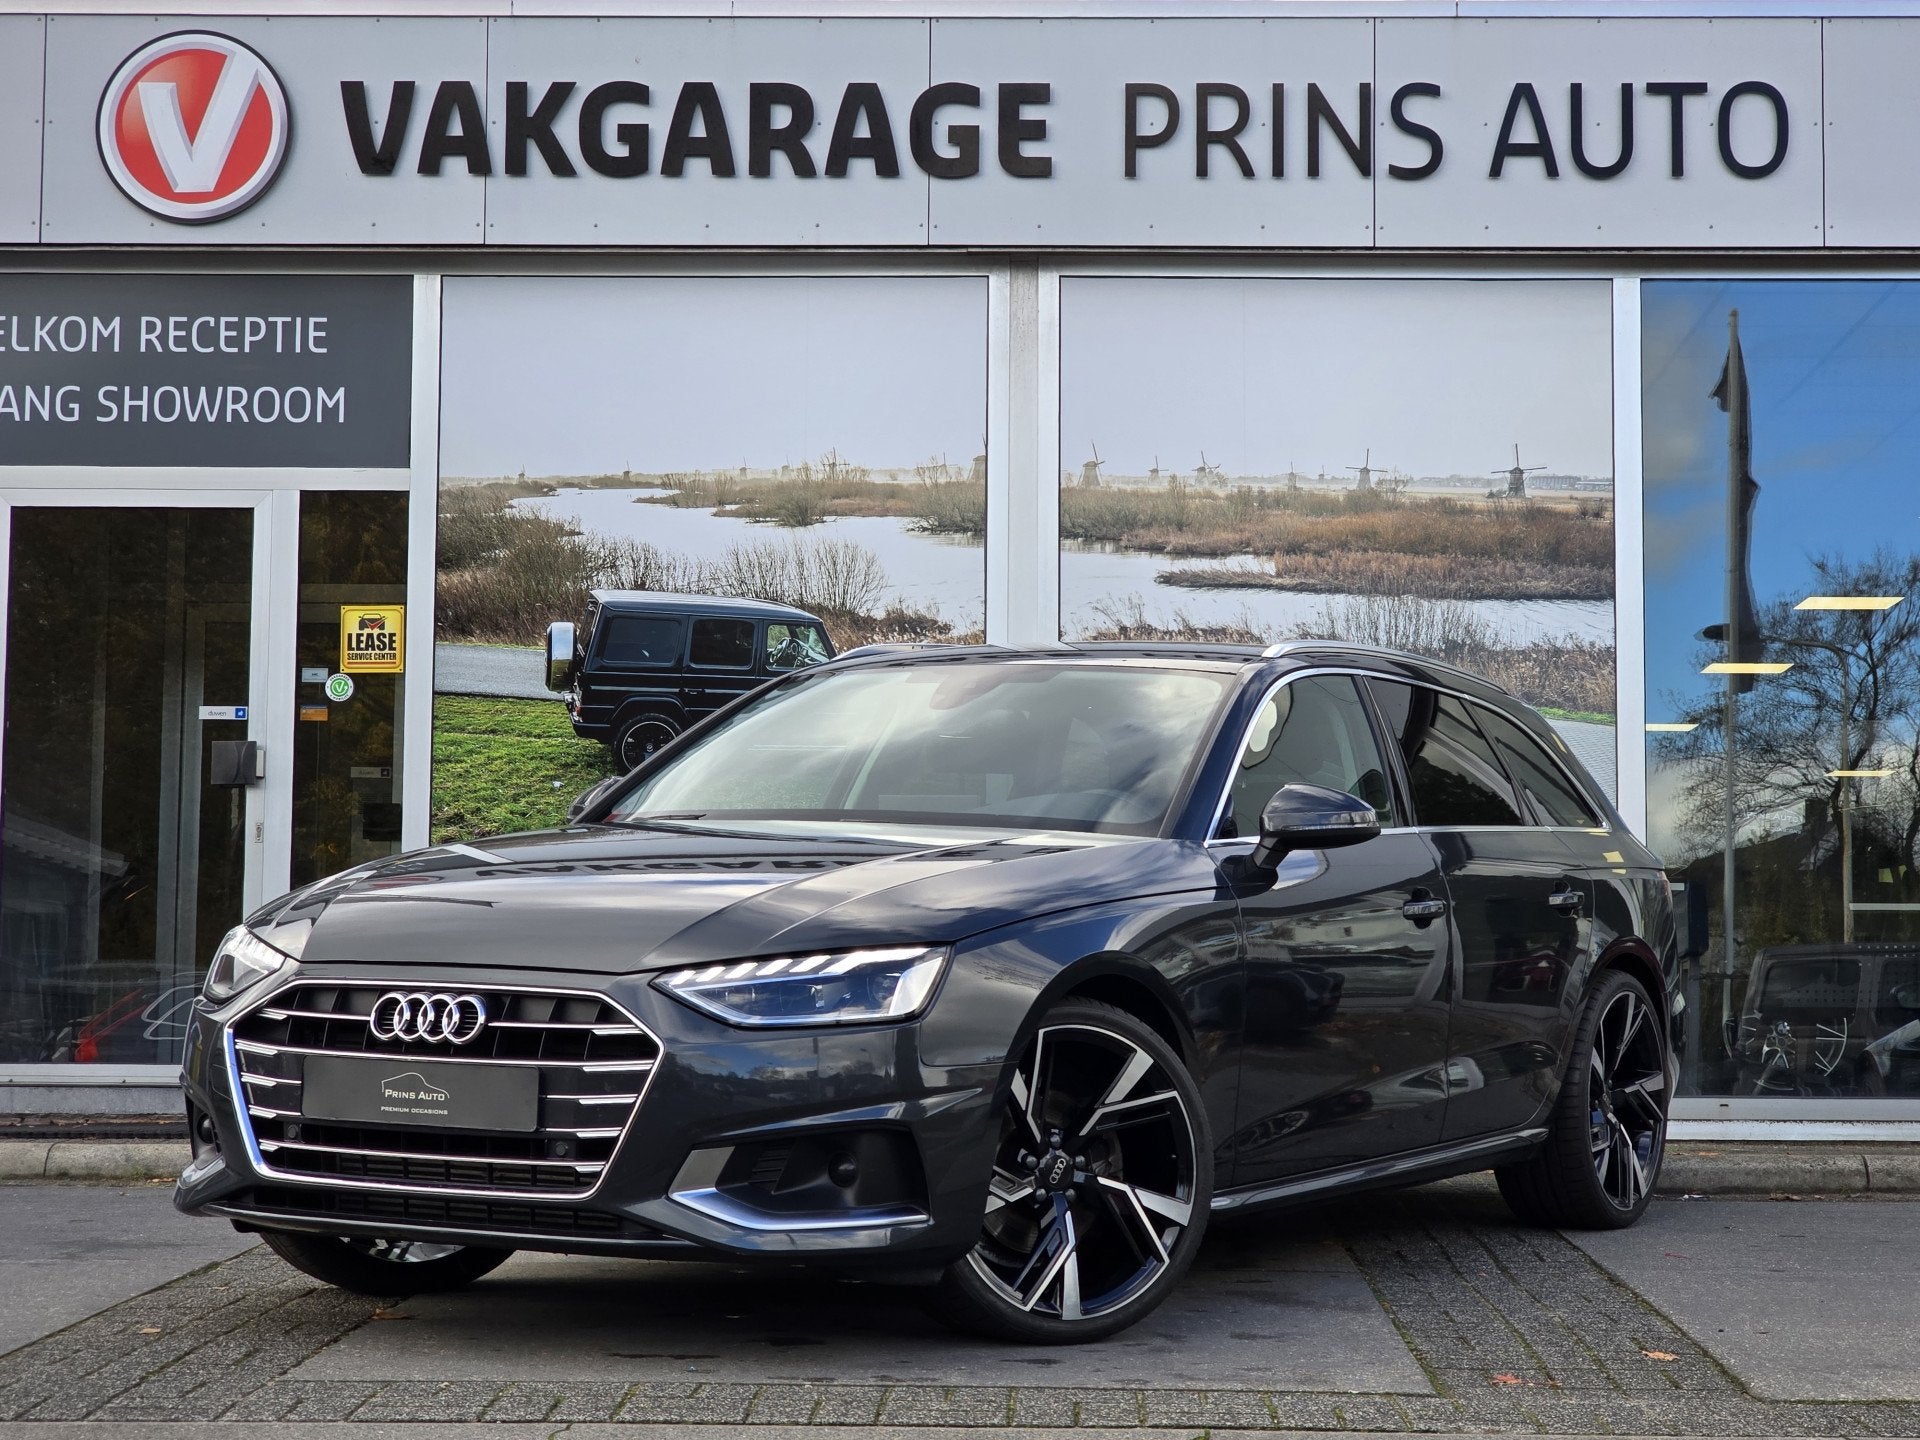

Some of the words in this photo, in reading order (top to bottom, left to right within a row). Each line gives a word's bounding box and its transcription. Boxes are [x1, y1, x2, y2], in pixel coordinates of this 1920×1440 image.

[340, 80, 1054, 179] VAKGARAGE
[1124, 81, 1443, 181] PRINS
[1488, 81, 1790, 180] AUTO
[140, 316, 328, 354] RECEPTIE
[96, 386, 346, 423] SHOWROOM
[347, 632, 397, 652] LEASE
[347, 652, 373, 661] SERVICE
[373, 652, 397, 661] CENTER
[385, 1089, 416, 1100] PRINS
[418, 1091, 445, 1101] AUTO
